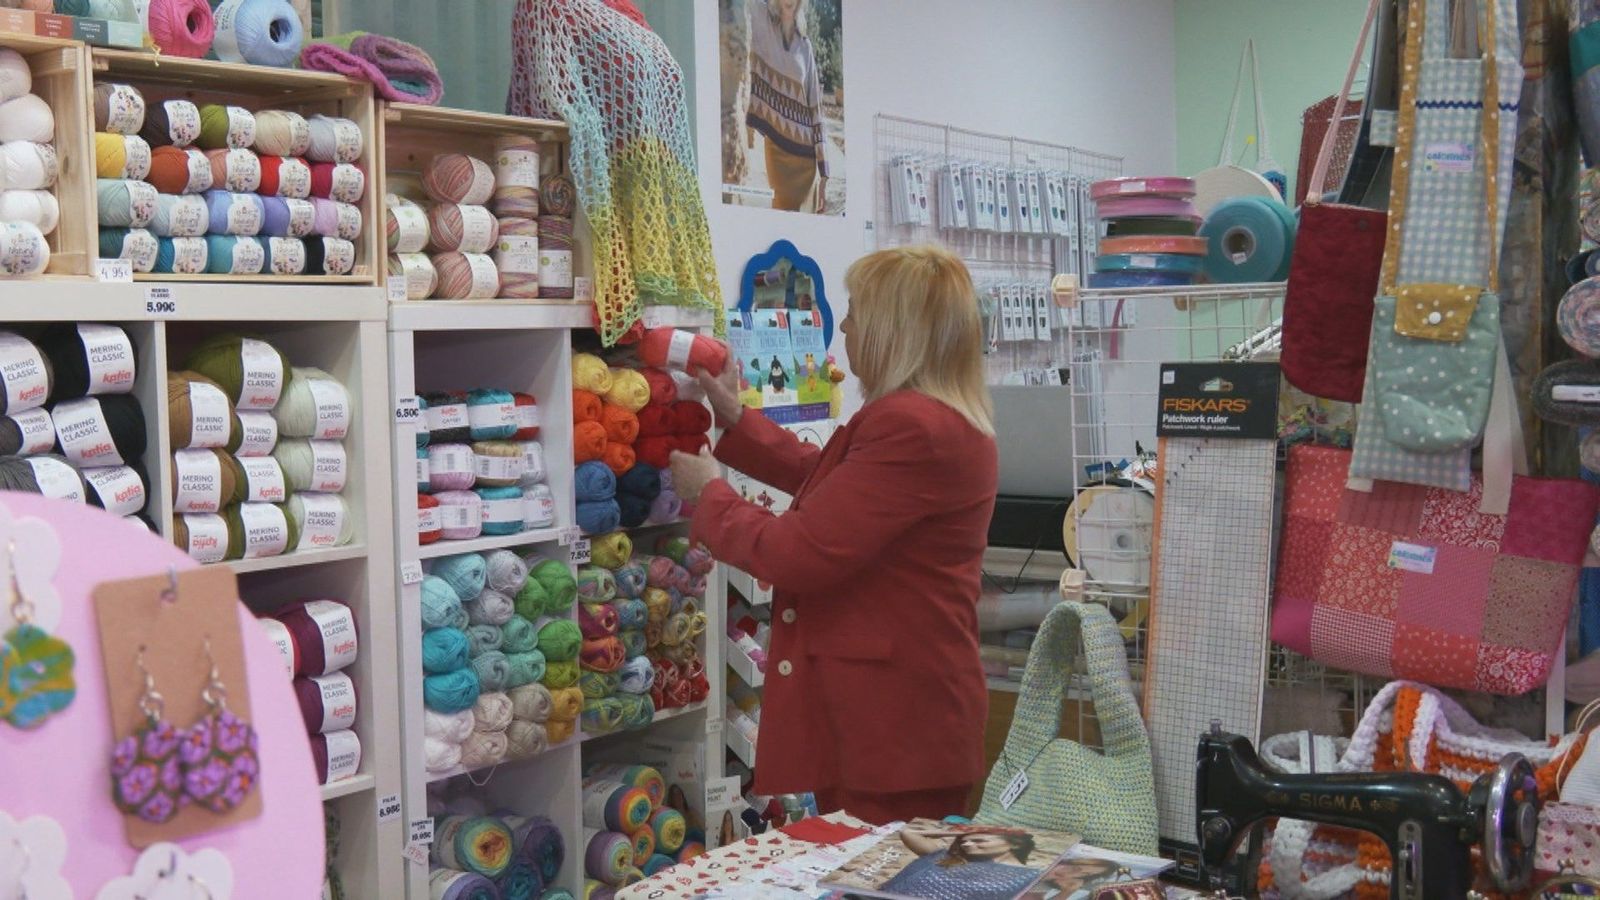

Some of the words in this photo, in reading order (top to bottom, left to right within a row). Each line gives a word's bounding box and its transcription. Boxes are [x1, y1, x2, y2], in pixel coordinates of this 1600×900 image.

[147, 301, 175, 312] 5.99€
[90, 344, 123, 355] MERINO
[92, 352, 125, 363] CLASSIC
[3, 358, 35, 373] MERINO
[7, 367, 38, 381] CLASSIC
[102, 370, 131, 384] katia
[247, 371, 276, 380] MERINO
[246, 379, 276, 388] CLASSIC
[19, 385, 45, 401] katia
[319, 403, 342, 412] MERINO
[1163, 397, 1247, 413] FISKARS
[319, 411, 343, 420] CLASSIC
[396, 408, 419, 418] 6.50€
[1162, 413, 1206, 424] Patchwork
[1207, 414, 1229, 424] ruler
[196, 416, 223, 424] MERINO
[61, 418, 96, 434] MERINO
[195, 424, 223, 432] CLASSIC
[246, 427, 271, 436] MERINO
[64, 426, 99, 442] CLASSIC
[246, 434, 271, 443] CLASSIC
[81, 443, 112, 459] katia
[316, 457, 341, 465] MERINO
[316, 464, 341, 473] CLASSIC
[182, 474, 214, 483] MERINO
[182, 483, 213, 491] CLASSIC
[114, 485, 141, 503] katia
[308, 511, 336, 519] MERINO
[307, 518, 336, 527] CLASSIC
[249, 526, 280, 536] MERINO
[249, 534, 280, 545] CLASSIC
[322, 617, 347, 630] MERINO
[325, 625, 348, 638] CLASSIC
[322, 681, 347, 691] MERINO
[324, 689, 348, 700] CLASSIC
[331, 752, 355, 763] MERINO
[331, 760, 354, 771] CLASSIC
[1300, 793, 1362, 811] SIGMA
